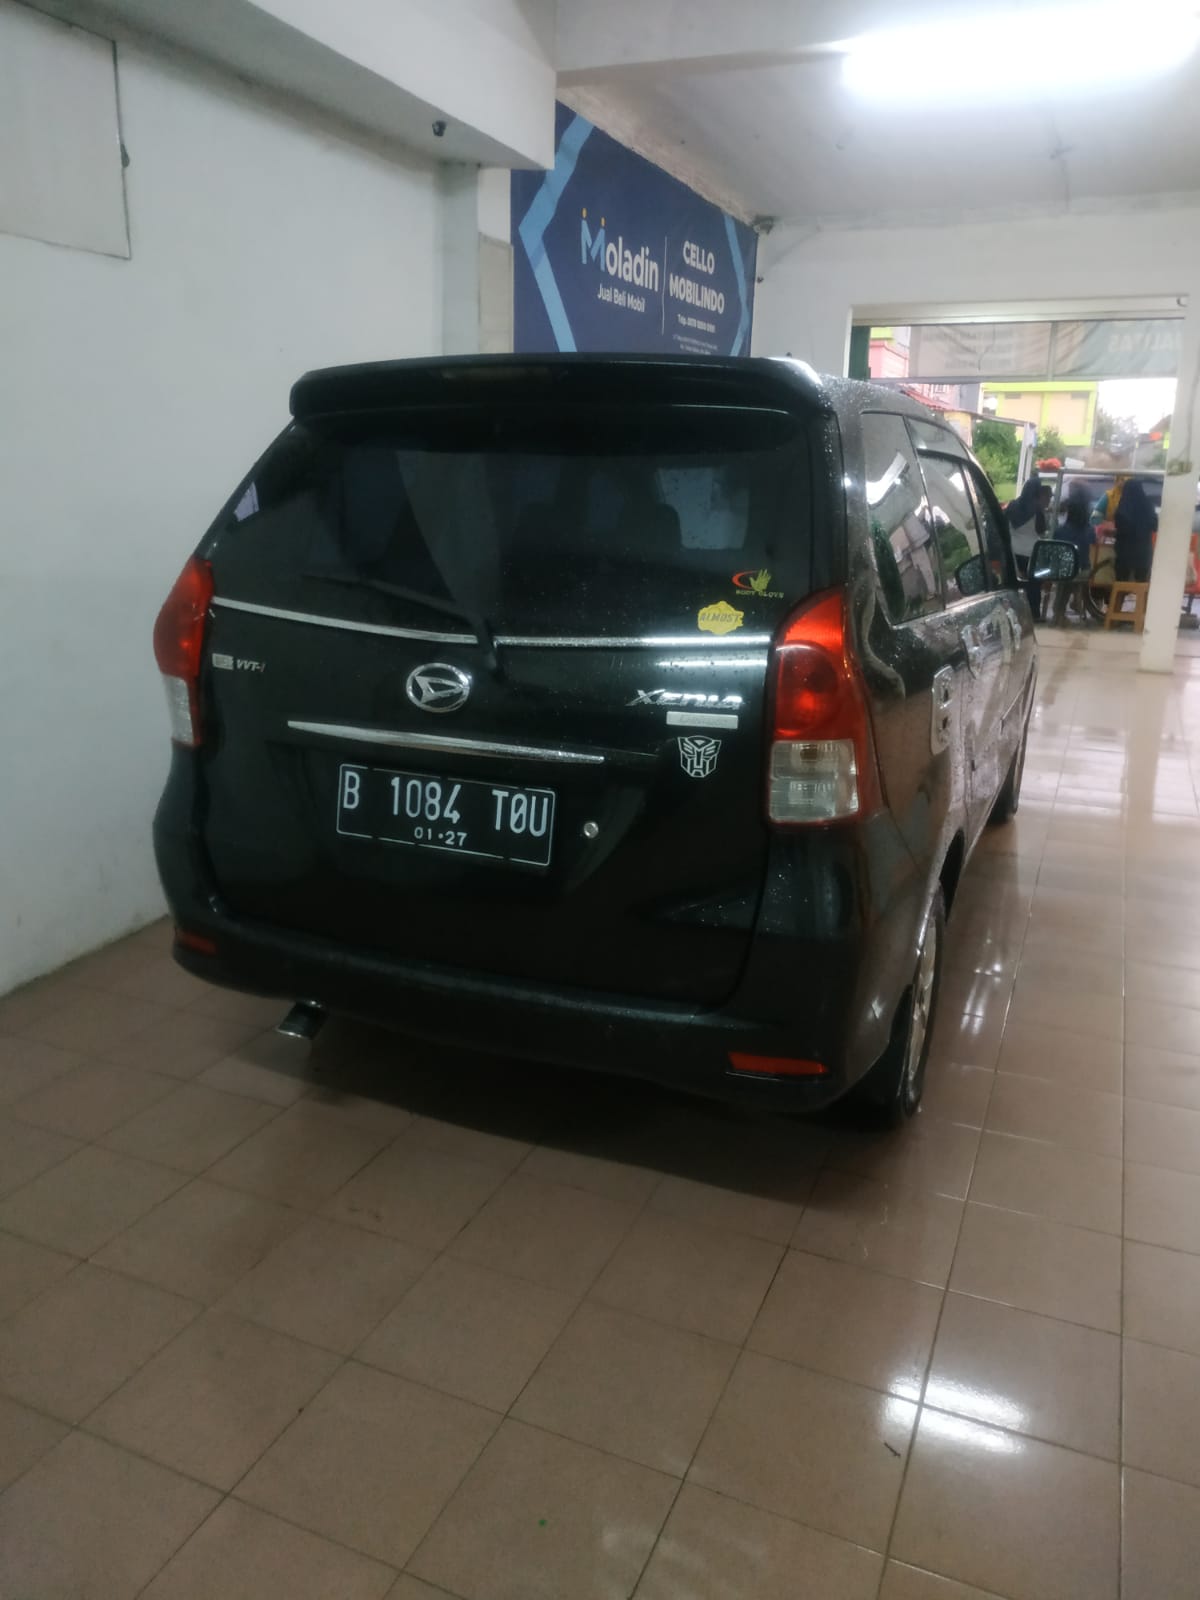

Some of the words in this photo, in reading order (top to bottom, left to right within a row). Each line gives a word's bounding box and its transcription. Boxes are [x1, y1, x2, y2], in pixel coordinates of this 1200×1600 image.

[581, 208, 659, 292] Moladin
[683, 240, 716, 275] CELLO
[597, 284, 613, 303] Jual
[613, 288, 627, 308] Beli
[628, 292, 646, 313] Mobil
[669, 273, 726, 315] MOBILINDO
[700, 611, 741, 624] ALMOST
[343, 770, 361, 810] B
[390, 776, 462, 824] 1084
